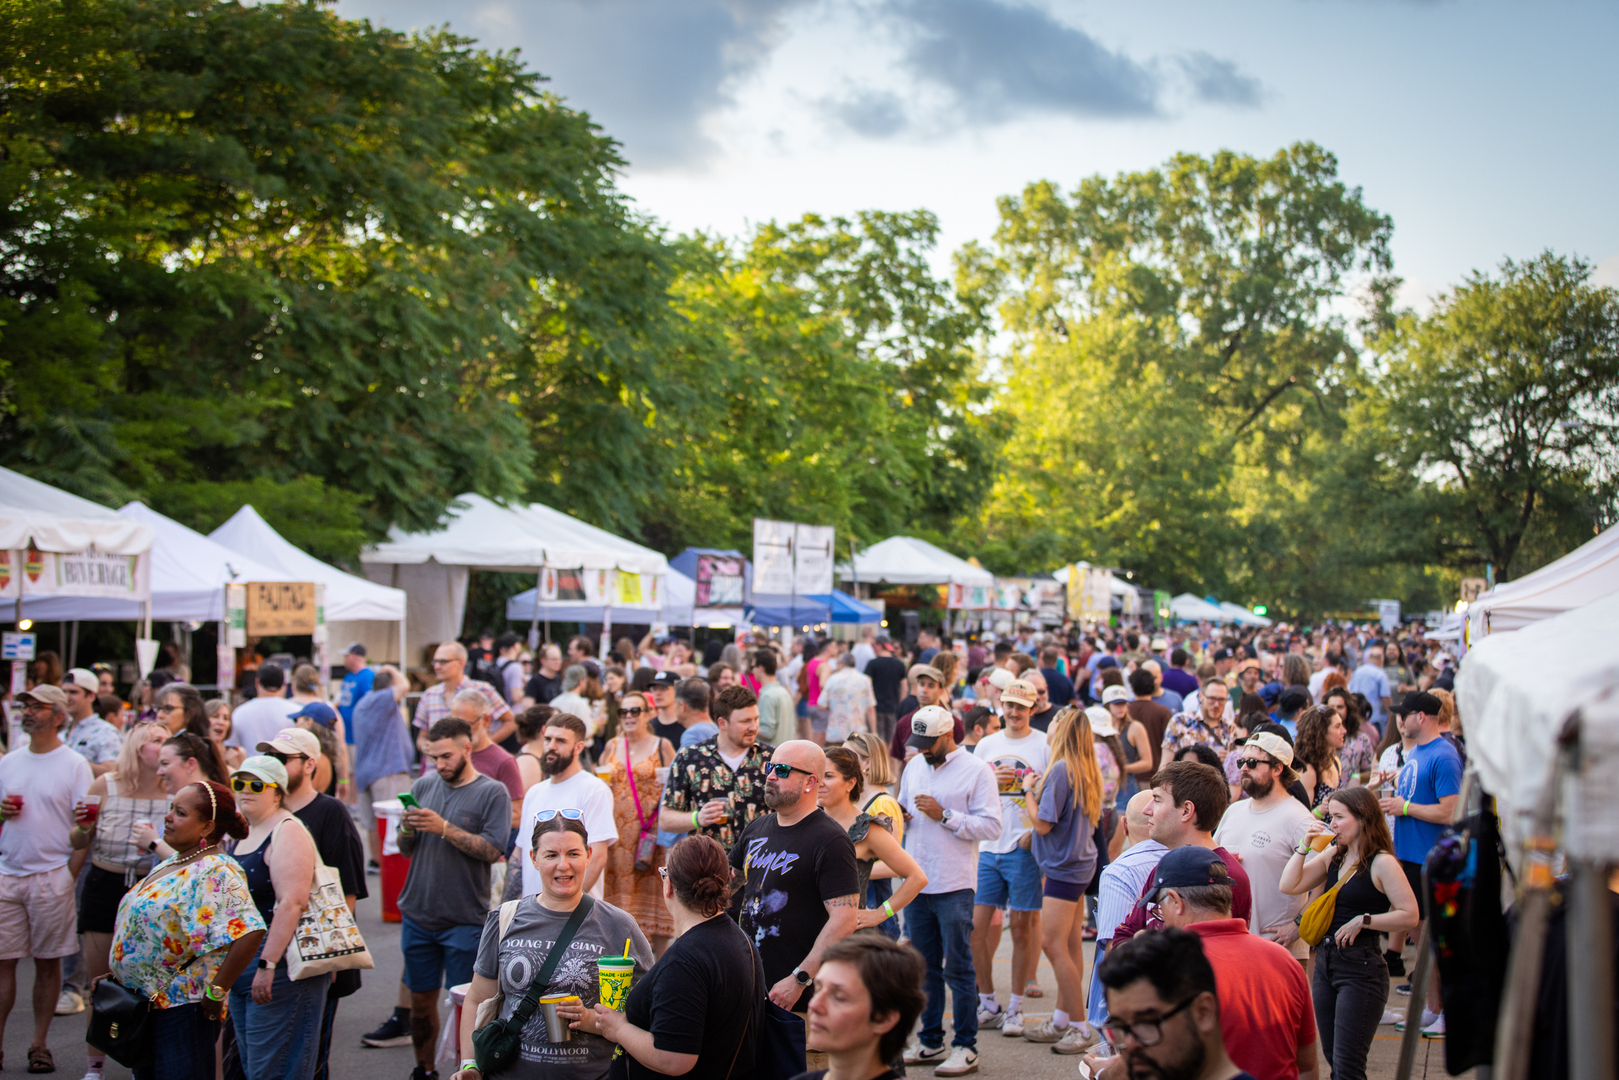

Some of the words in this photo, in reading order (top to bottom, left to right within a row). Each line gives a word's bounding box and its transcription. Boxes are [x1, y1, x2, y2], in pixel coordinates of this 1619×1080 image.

[743, 837, 800, 889] Prince
[506, 939, 542, 949] YOUNG
[571, 941, 606, 954] GIANT
[530, 1045, 589, 1056] BOLLYWOOD
